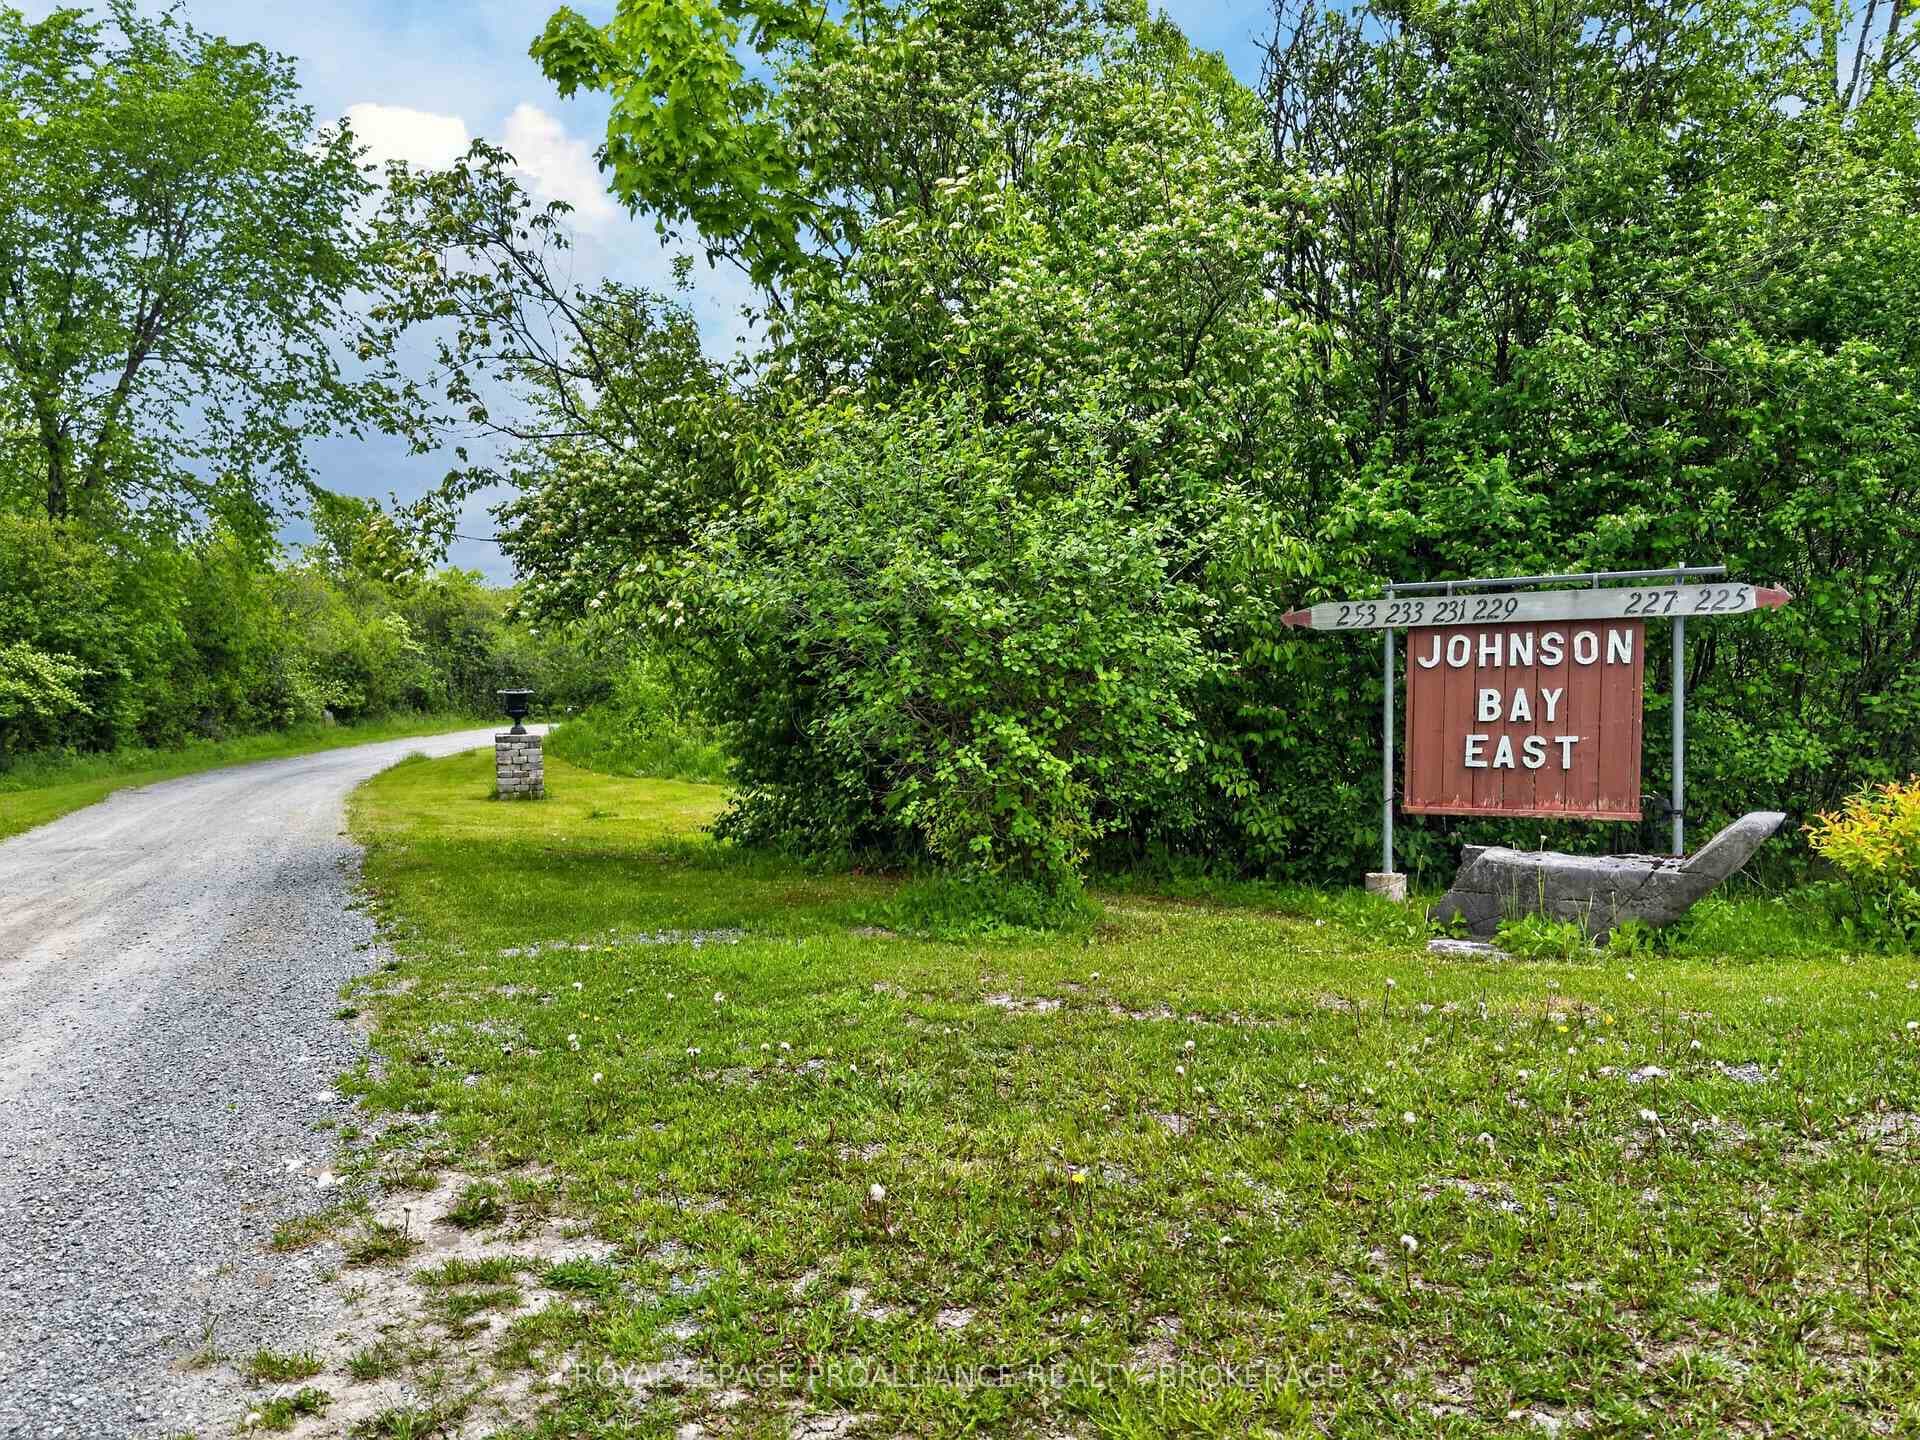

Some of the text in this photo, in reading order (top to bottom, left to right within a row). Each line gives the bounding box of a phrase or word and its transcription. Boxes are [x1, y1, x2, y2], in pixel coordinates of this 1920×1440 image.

[1336, 586, 1749, 627] 253 233 231 229 227 225
[1417, 629, 1633, 669] JOHNSON
[1478, 687, 1563, 722] BAY
[1464, 734, 1579, 769] EAST
